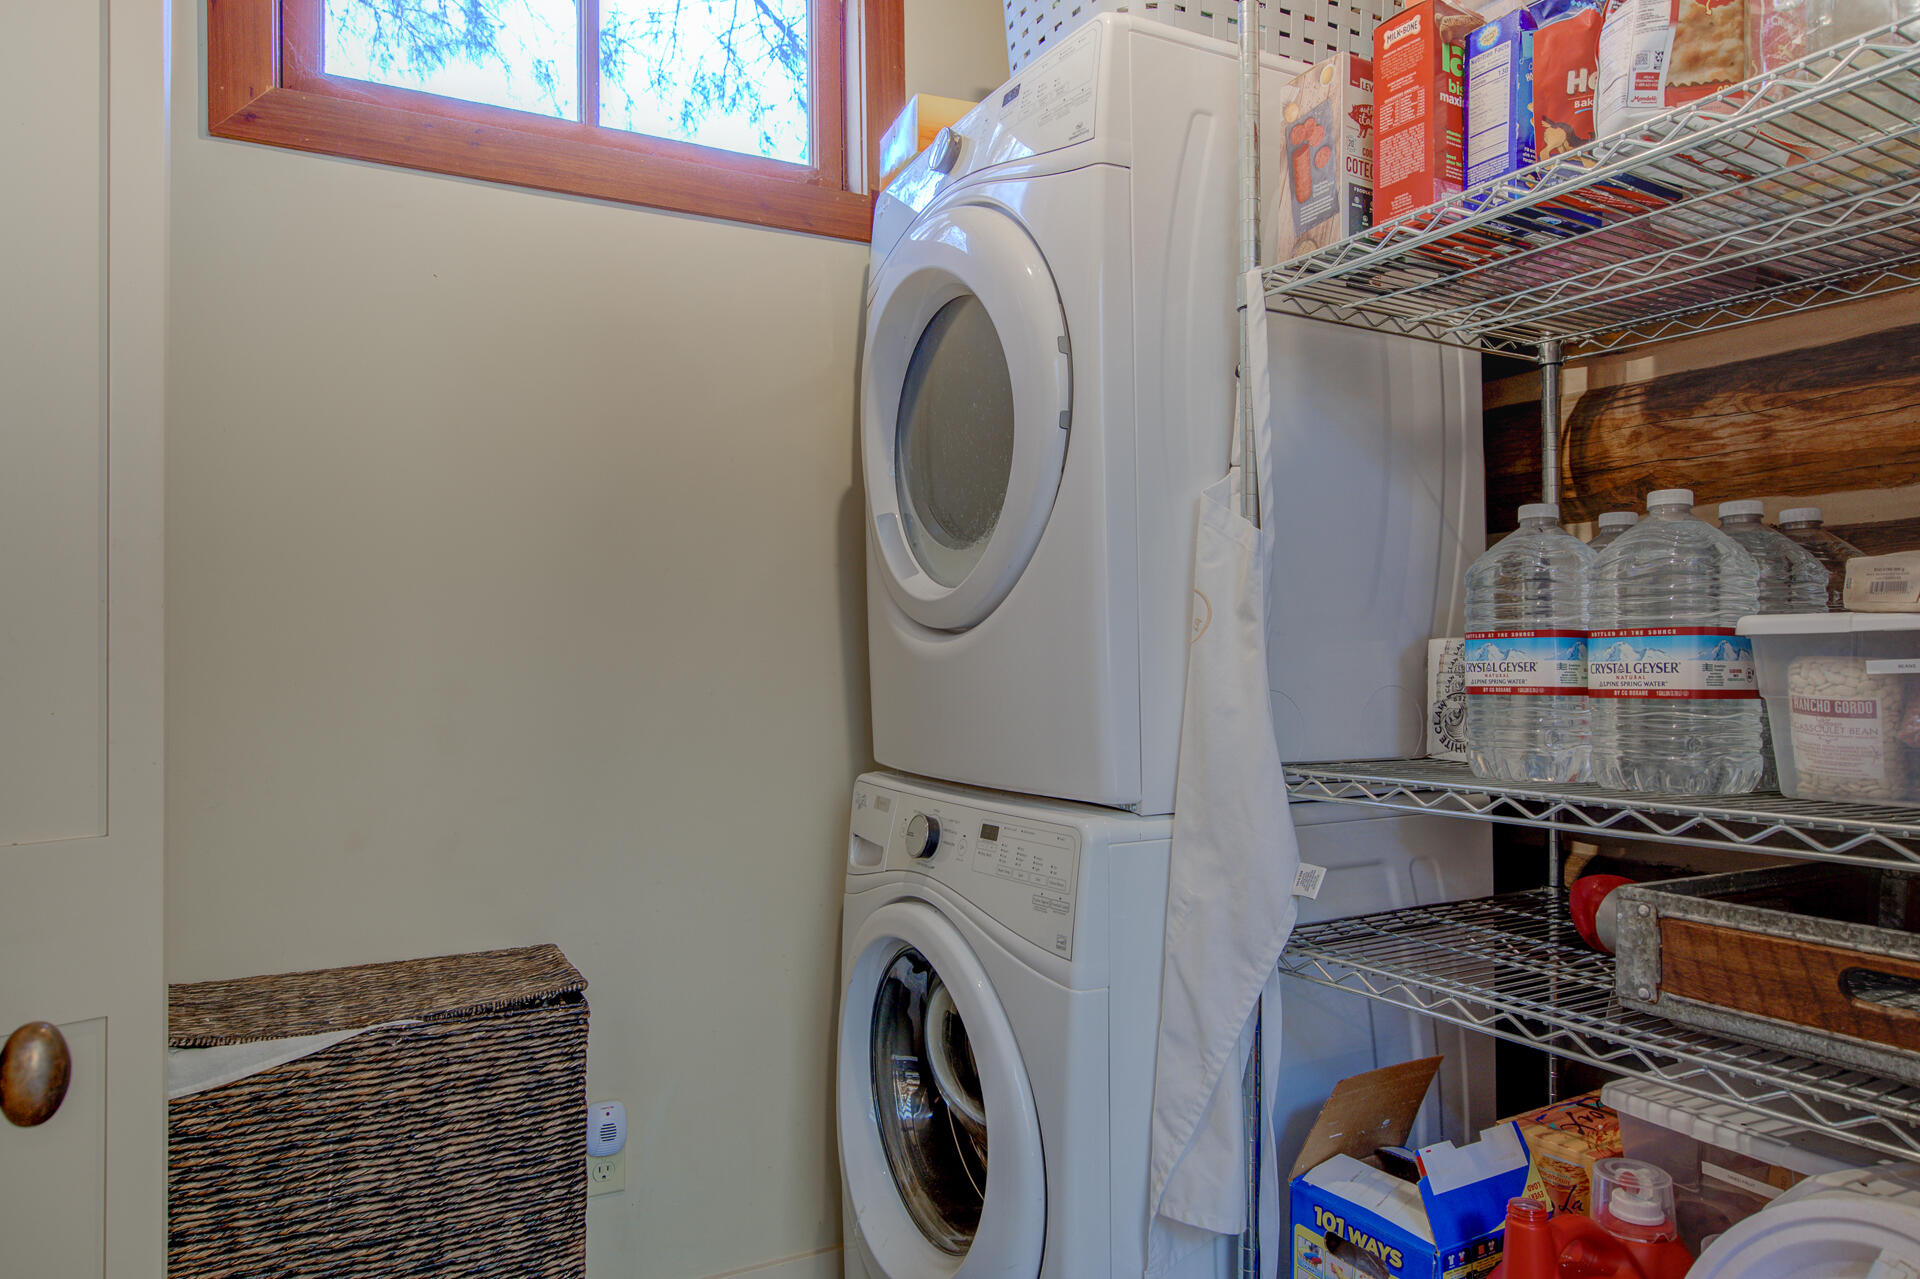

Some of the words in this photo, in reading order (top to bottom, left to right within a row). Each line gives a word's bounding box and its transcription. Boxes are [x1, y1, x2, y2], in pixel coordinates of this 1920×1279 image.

[1465, 662, 1498, 673] CRYSTAL
[1499, 661, 1537, 673] GEYSER
[1590, 662, 1632, 675] CRYSTAL
[1633, 662, 1679, 674] GEYSER
[1793, 697, 1831, 713] RANCHO
[1834, 700, 1873, 714] GORDO
[1434, 699, 1448, 734] CLAW
[1849, 727, 1879, 736] BEAN
[1313, 1205, 1345, 1238] 101
[1347, 1225, 1403, 1268] WAYS
